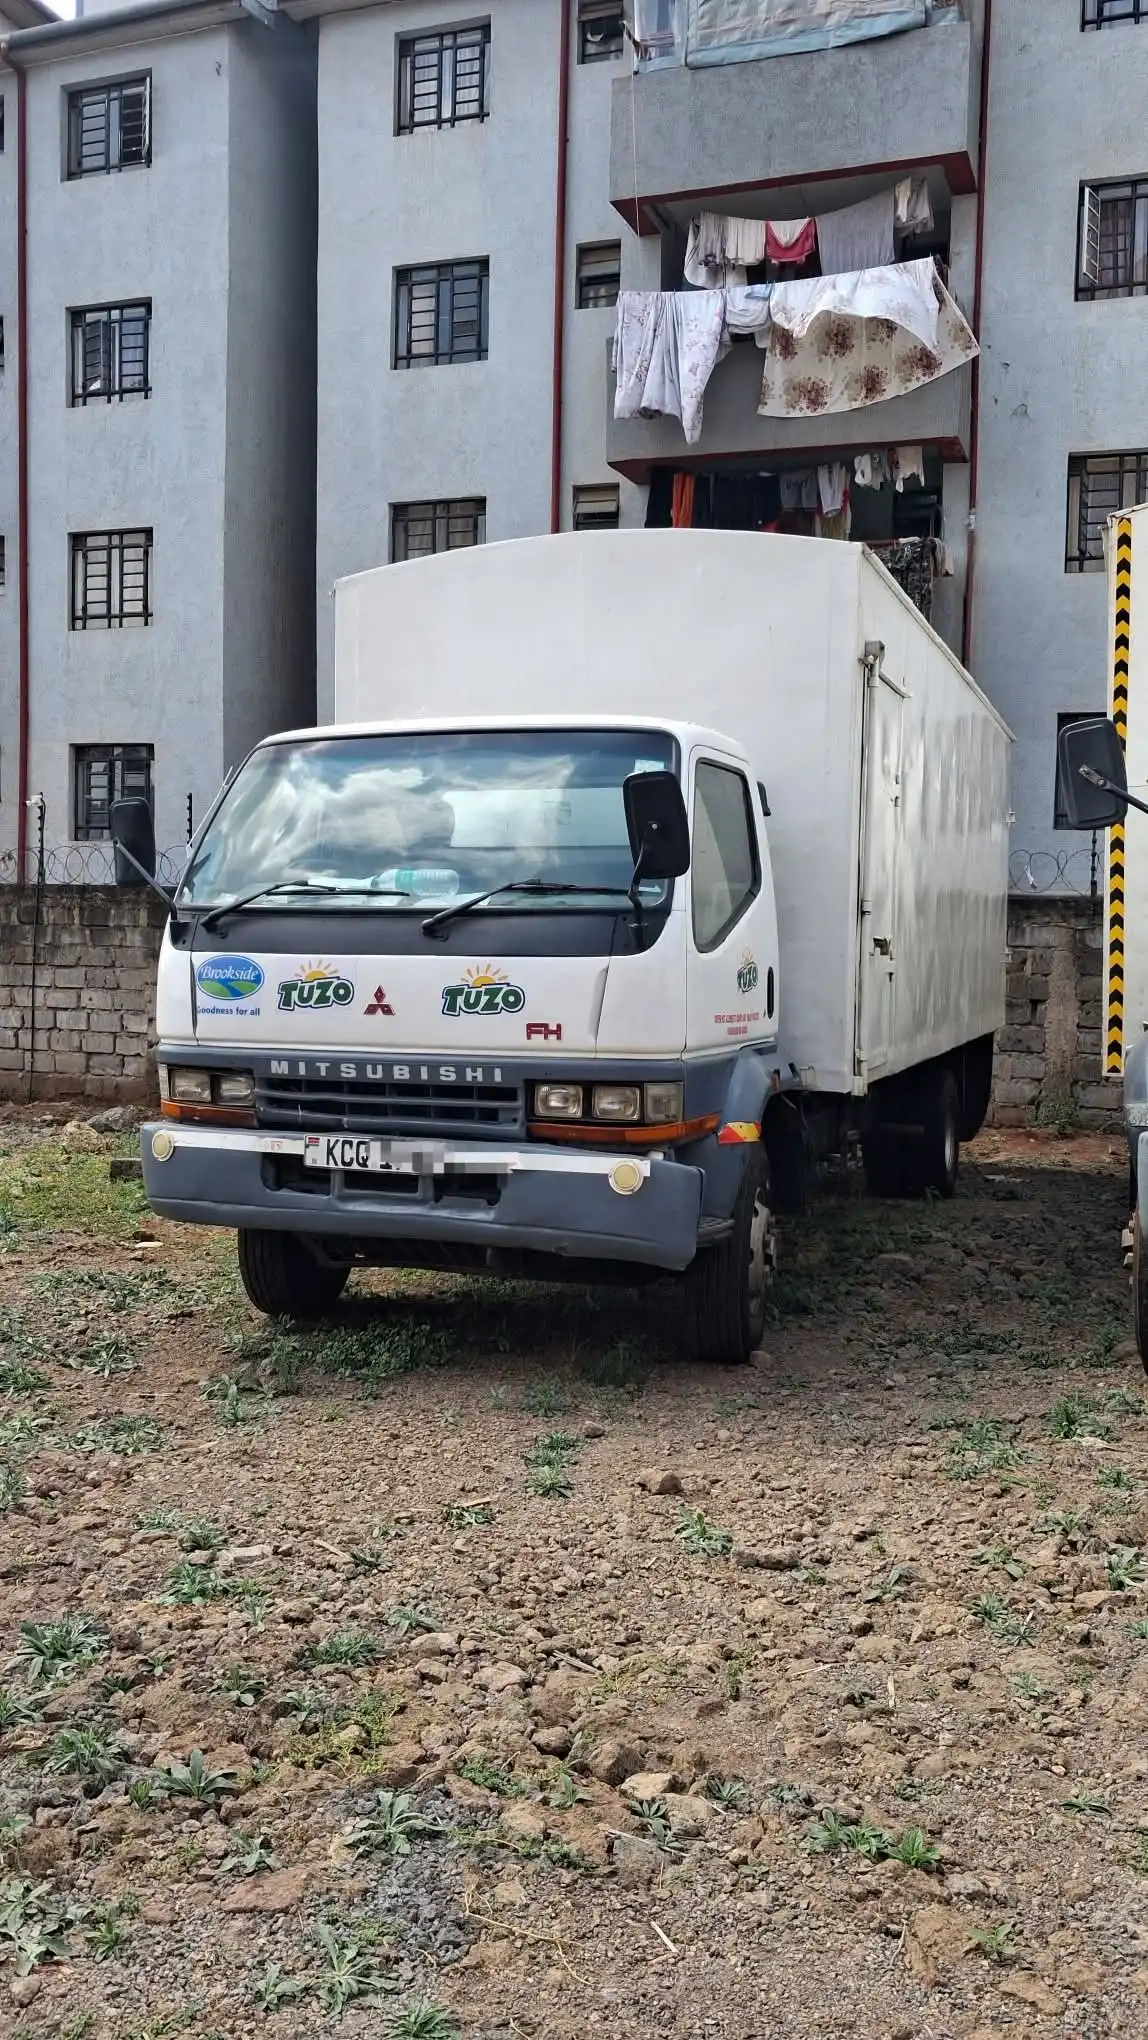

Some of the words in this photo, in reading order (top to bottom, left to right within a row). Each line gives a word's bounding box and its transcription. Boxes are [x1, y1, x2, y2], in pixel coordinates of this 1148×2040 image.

[201, 965, 258, 980] Brookside
[279, 977, 353, 1011] TUZO
[443, 984, 524, 1016] TUZO
[236, 1007, 248, 1016] for
[250, 1007, 260, 1016] all
[526, 1023, 562, 1040] FH
[271, 1060, 502, 1082] MITSUBISHI
